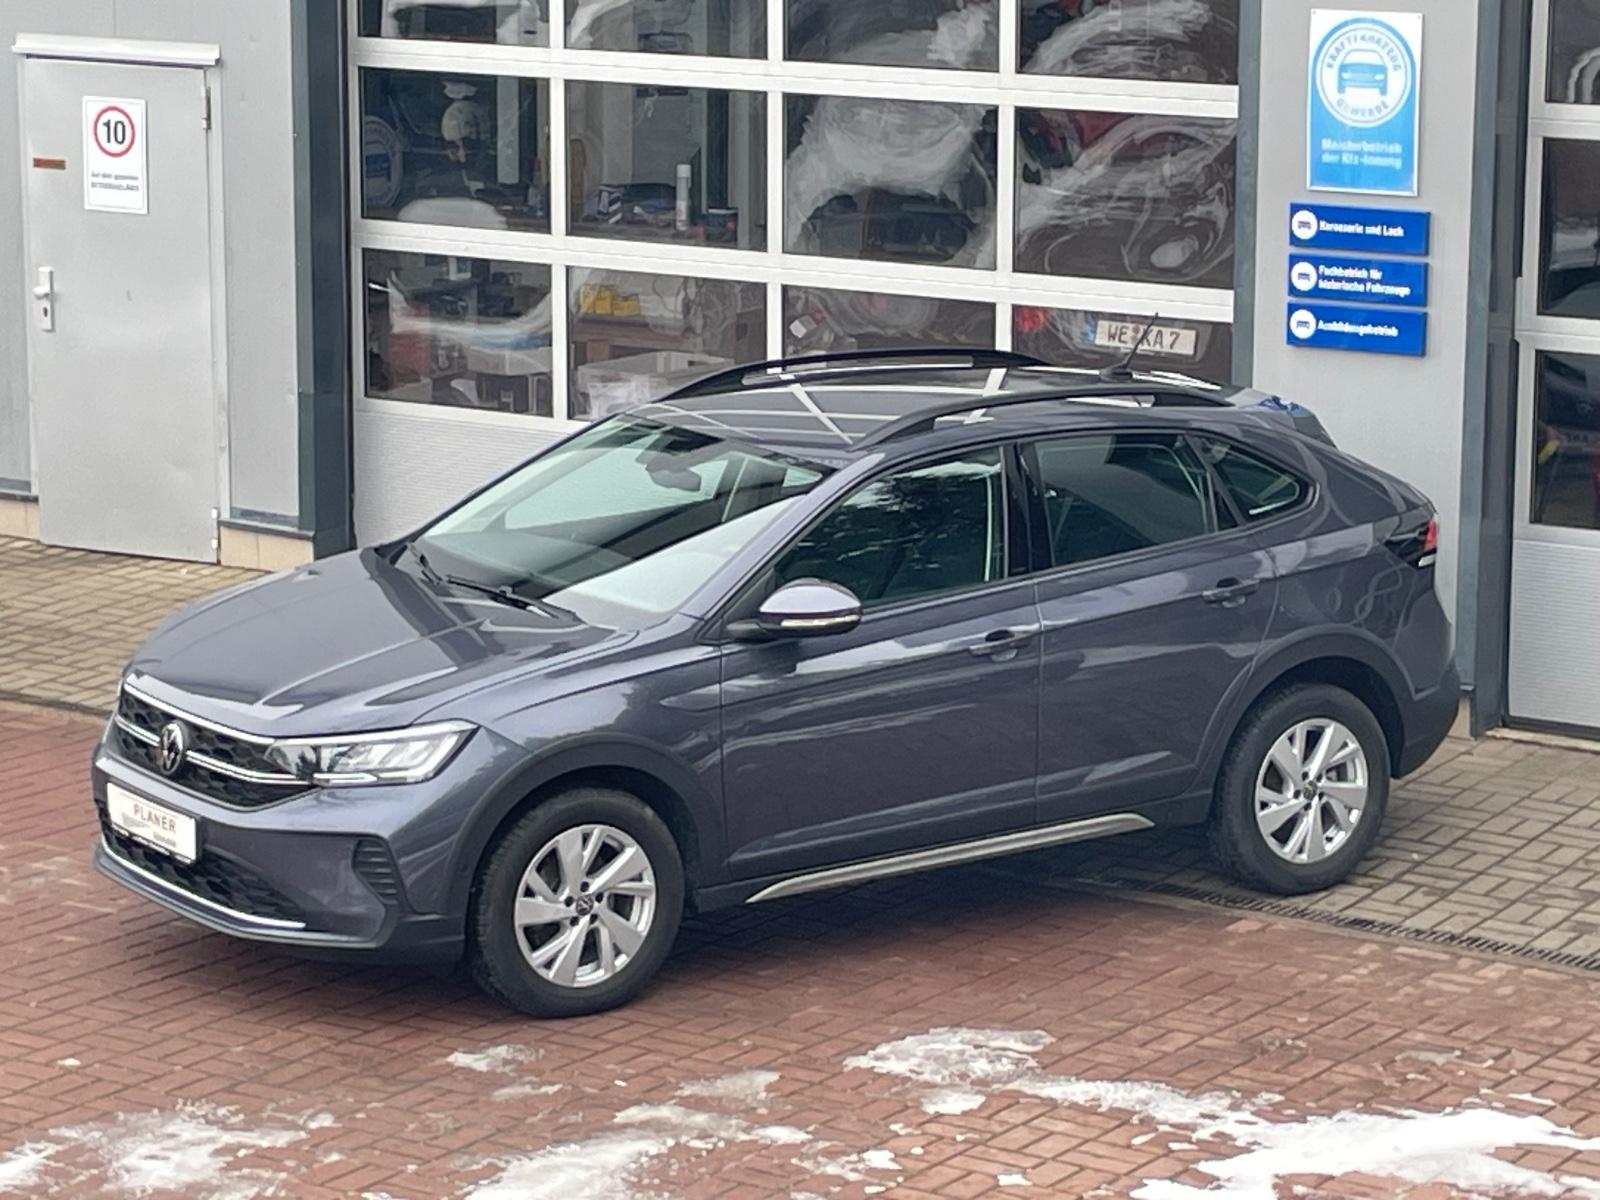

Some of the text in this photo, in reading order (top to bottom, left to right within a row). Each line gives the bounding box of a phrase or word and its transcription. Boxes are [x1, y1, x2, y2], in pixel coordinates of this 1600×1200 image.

[102, 119, 126, 145] 10
[1107, 323, 1130, 344] WE
[133, 803, 177, 833] PLANER
